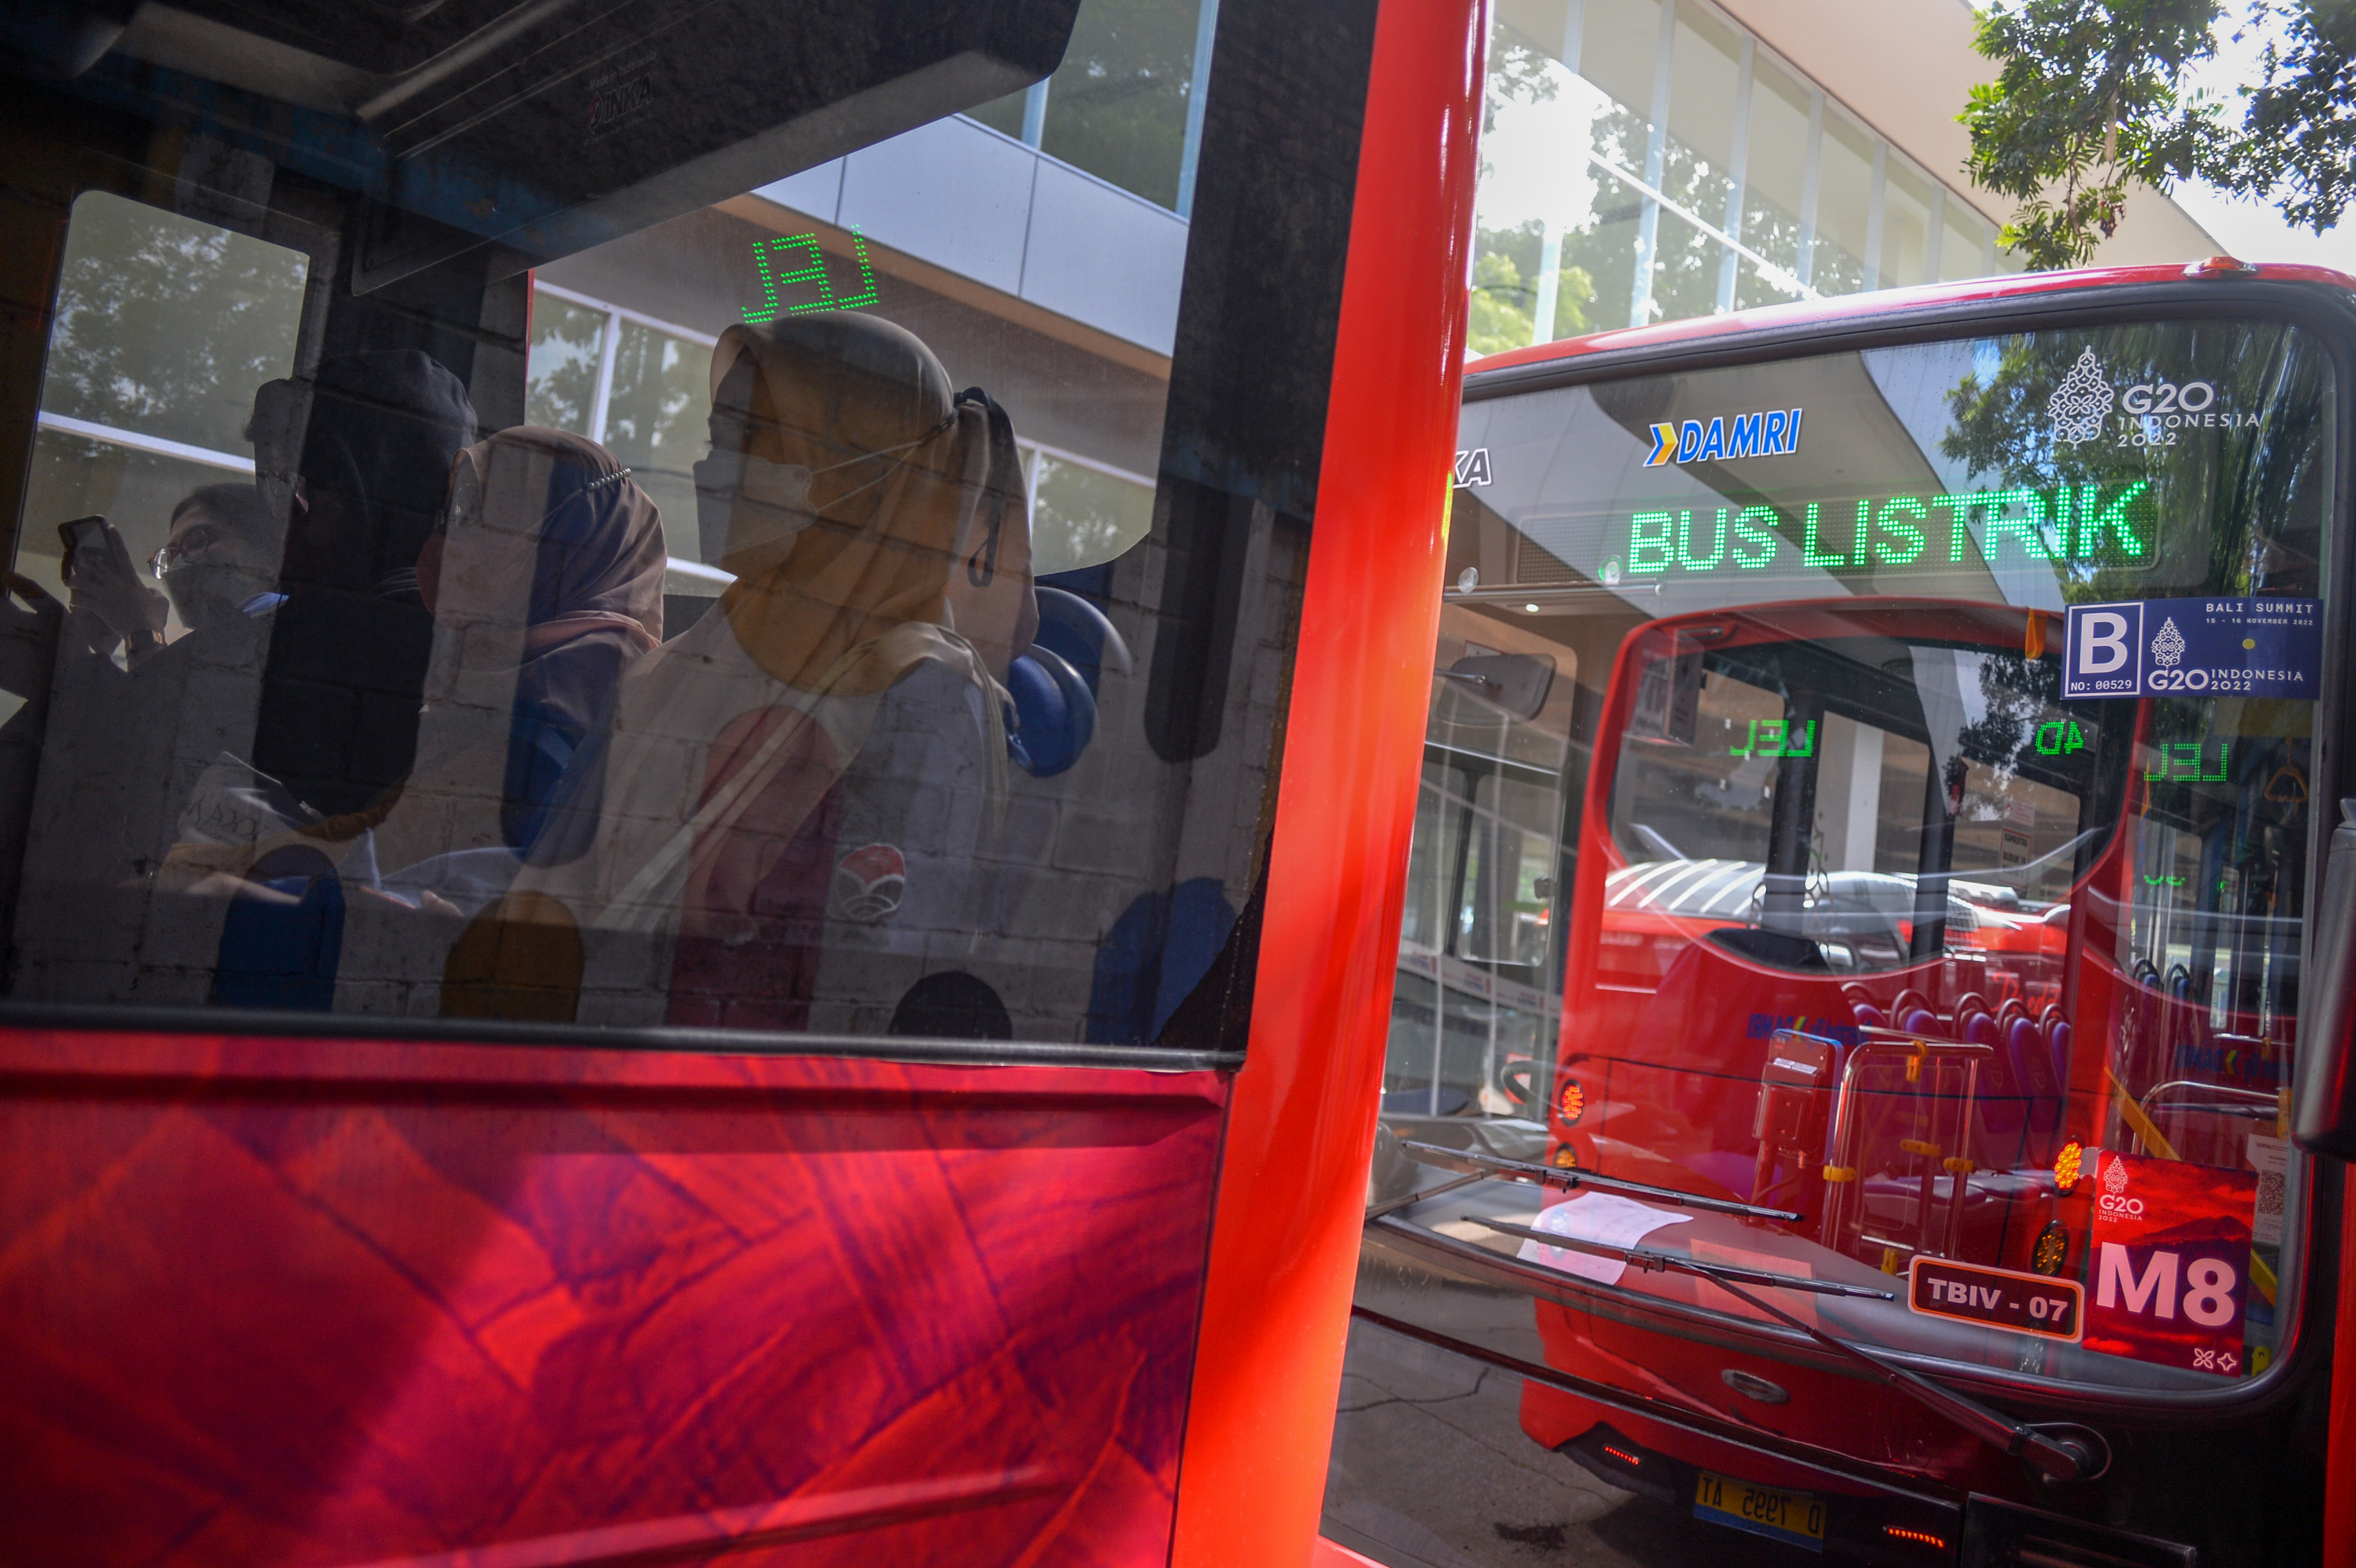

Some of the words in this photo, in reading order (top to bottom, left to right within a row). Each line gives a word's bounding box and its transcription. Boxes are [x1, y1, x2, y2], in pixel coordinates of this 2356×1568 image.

[603, 73, 653, 124] INKA
[2122, 381, 2214, 414] G20
[2119, 413, 2260, 431] INDONESIA
[1676, 408, 1803, 464] DAMRI
[2117, 432, 2178, 447] 2022
[1628, 505, 1779, 574] BUS
[1804, 481, 2146, 567] LISTRIK
[2206, 603, 2244, 613] BALI
[2255, 603, 2314, 614] SUMMIT
[2079, 612, 2127, 674] B
[2070, 682, 2091, 692] NO:
[2095, 680, 2132, 690] 00529
[2147, 669, 2209, 691] G20
[2211, 669, 2304, 682] INDONESIA
[2211, 681, 2251, 691] 2022
[2098, 1209, 2143, 1221] INDONESIA
[2099, 1194, 2144, 1215] G20
[2097, 1215, 2118, 1223] 2022
[2096, 1241, 2236, 1326] M8
[1927, 1277, 2002, 1310] TBIV
[2029, 1296, 2069, 1322] 07
